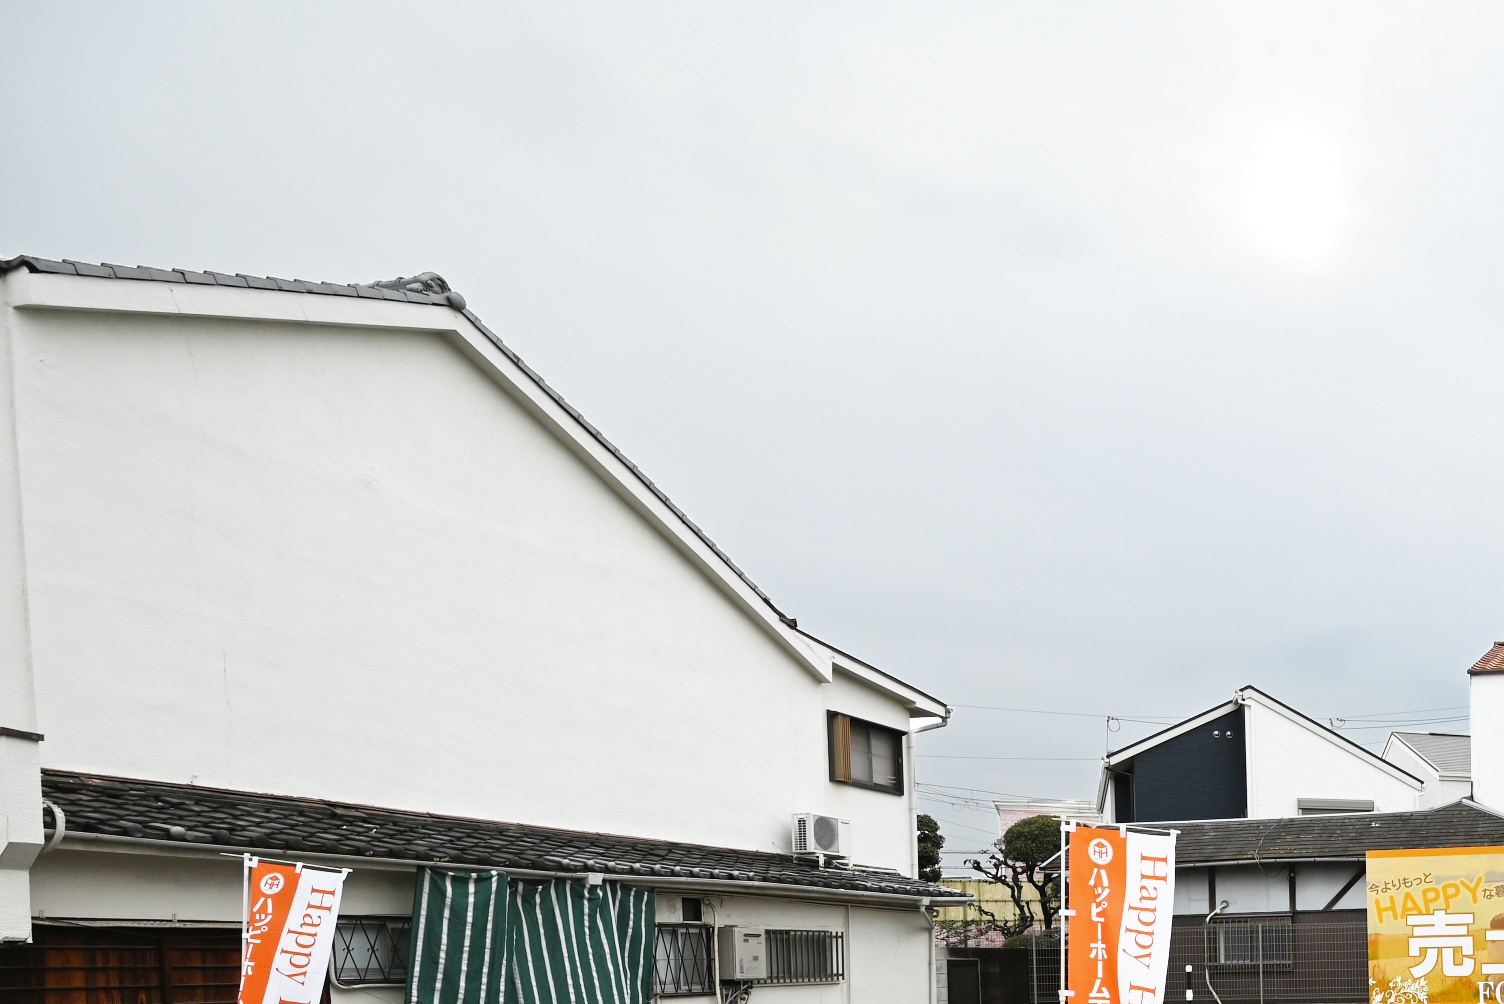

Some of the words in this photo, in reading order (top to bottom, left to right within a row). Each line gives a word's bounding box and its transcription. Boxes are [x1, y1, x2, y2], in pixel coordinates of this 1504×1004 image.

[1122, 852, 1168, 970] Happy
[1368, 872, 1434, 895] 今よりもっと
[1375, 876, 1483, 924] HAPPY
[276, 885, 336, 986] Happy
